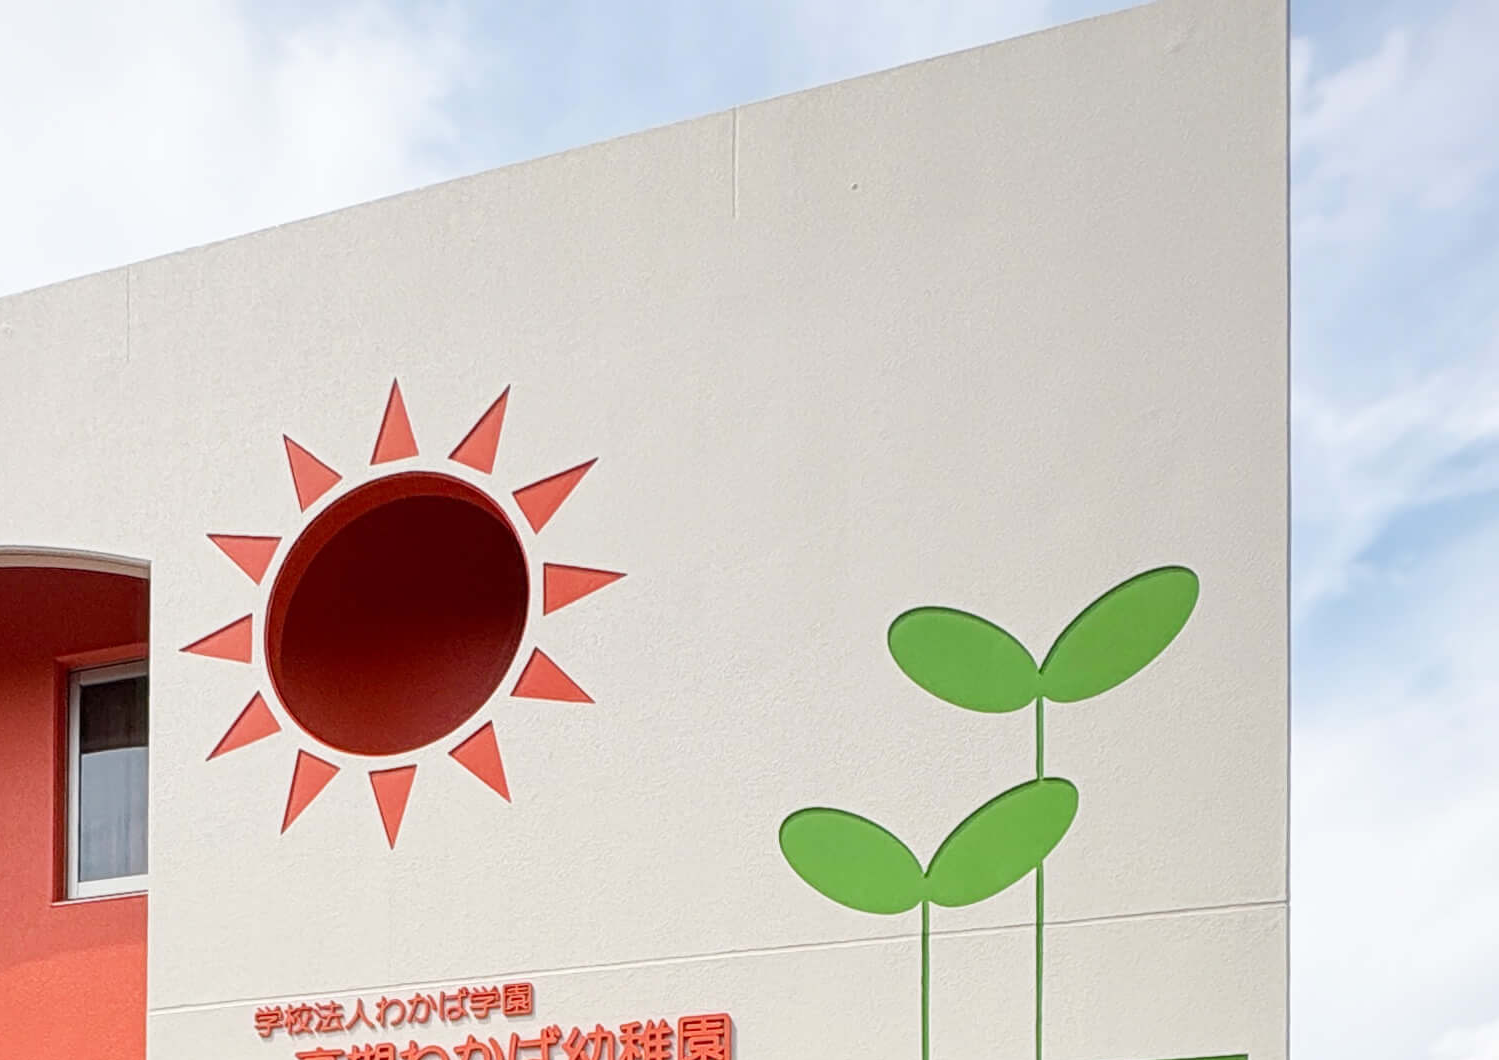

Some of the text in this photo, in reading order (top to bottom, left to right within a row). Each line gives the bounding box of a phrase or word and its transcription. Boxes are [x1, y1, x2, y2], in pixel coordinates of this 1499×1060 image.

[254, 983, 534, 1038] 学校法人わかば学園
